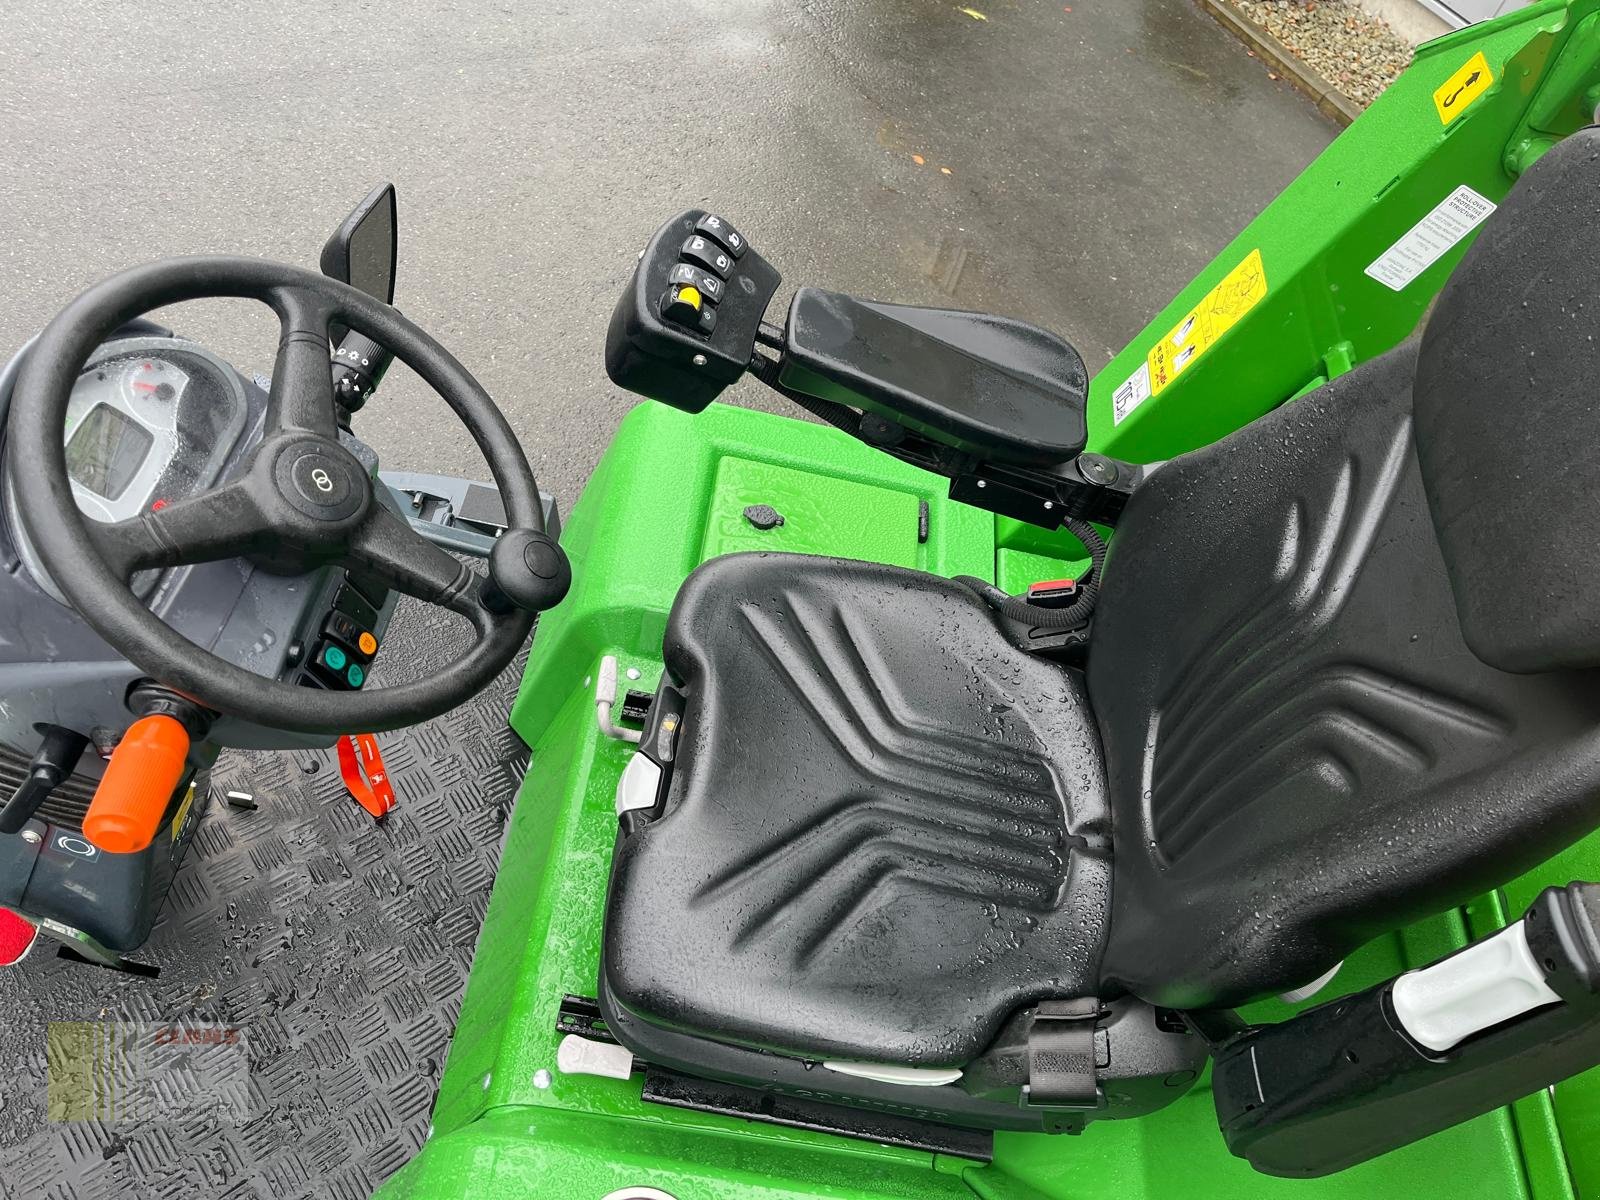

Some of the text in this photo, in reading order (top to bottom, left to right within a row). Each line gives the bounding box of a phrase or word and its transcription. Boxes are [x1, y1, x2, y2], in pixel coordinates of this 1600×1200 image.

[1448, 201, 1477, 220] STRUCTURE
[1453, 196, 1483, 216] PROTECTIVE
[1460, 193, 1487, 211] ROLL-OVER
[1115, 382, 1133, 411] 105
